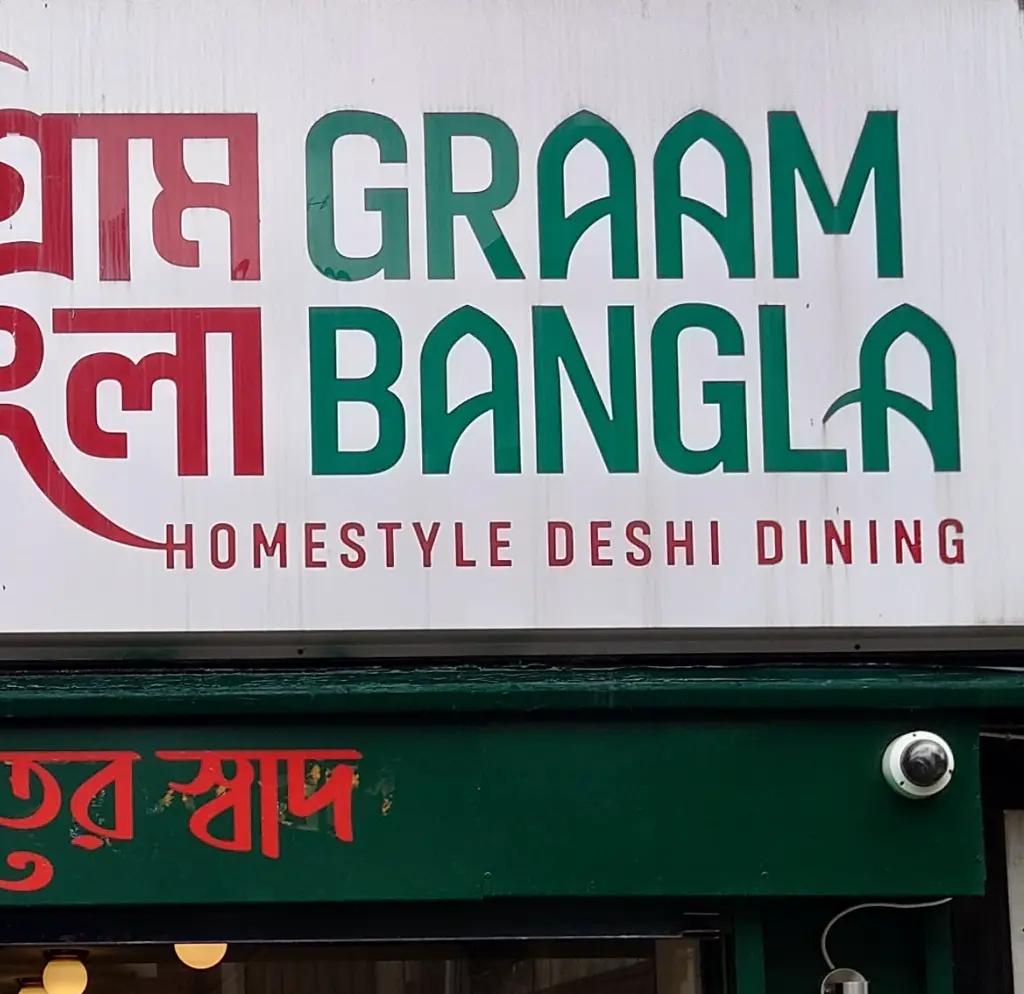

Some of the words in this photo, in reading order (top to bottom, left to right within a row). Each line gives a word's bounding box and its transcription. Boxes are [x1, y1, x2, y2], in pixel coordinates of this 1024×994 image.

[305, 109, 904, 282] GRAAM
[307, 303, 961, 476] BANGLA
[165, 522, 513, 570] HOMESTYLE
[547, 521, 721, 568] DESHI
[756, 519, 965, 566] DINING
[154, 748, 363, 860] স্বাদ
